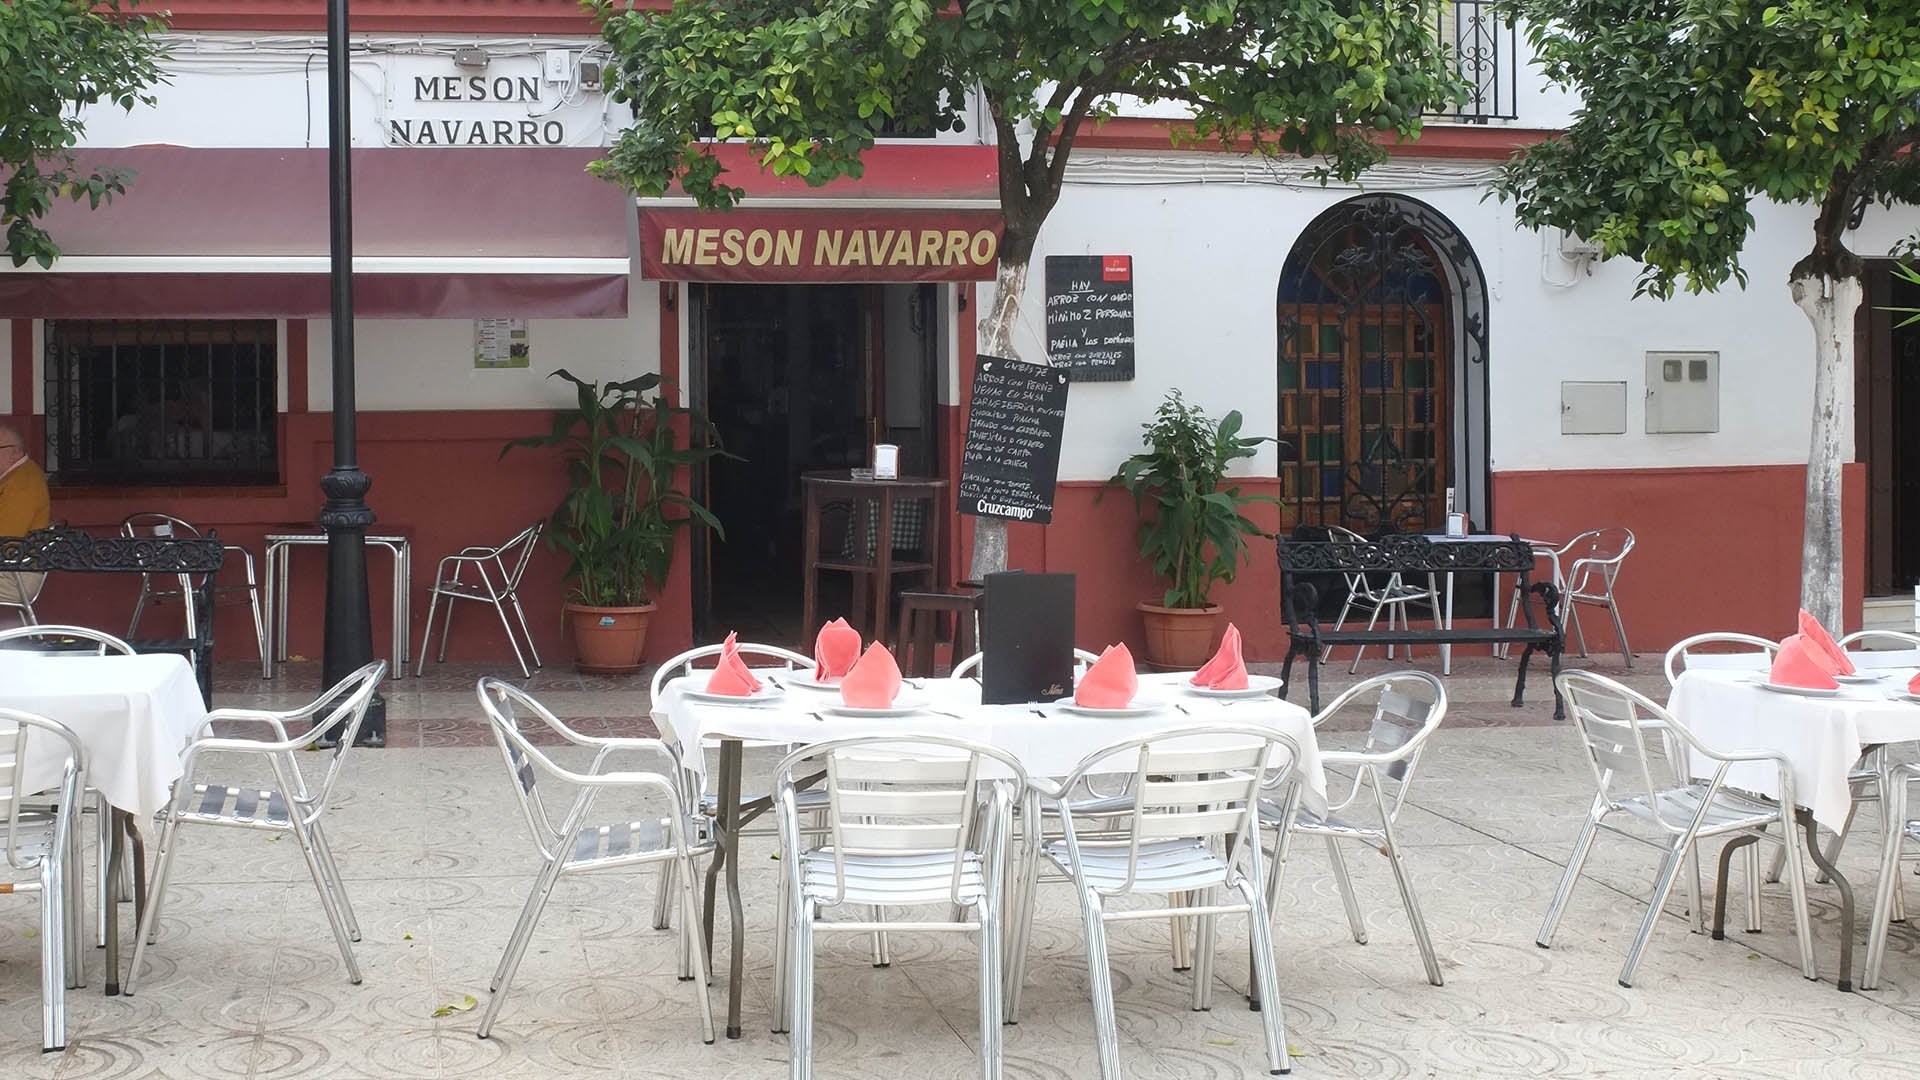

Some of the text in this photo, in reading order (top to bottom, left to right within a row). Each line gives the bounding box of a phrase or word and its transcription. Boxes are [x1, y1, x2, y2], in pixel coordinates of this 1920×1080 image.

[414, 76, 540, 101] MESON
[390, 119, 564, 145] NAVARRO
[661, 228, 997, 266] MESON NAVARRO
[1071, 280, 1090, 290] HAY
[1047, 294, 1079, 307] ARROZ
[1083, 309, 1092, 320] 2
[976, 372, 1005, 384] ARROZ
[977, 499, 1033, 520] Cruzcampo
